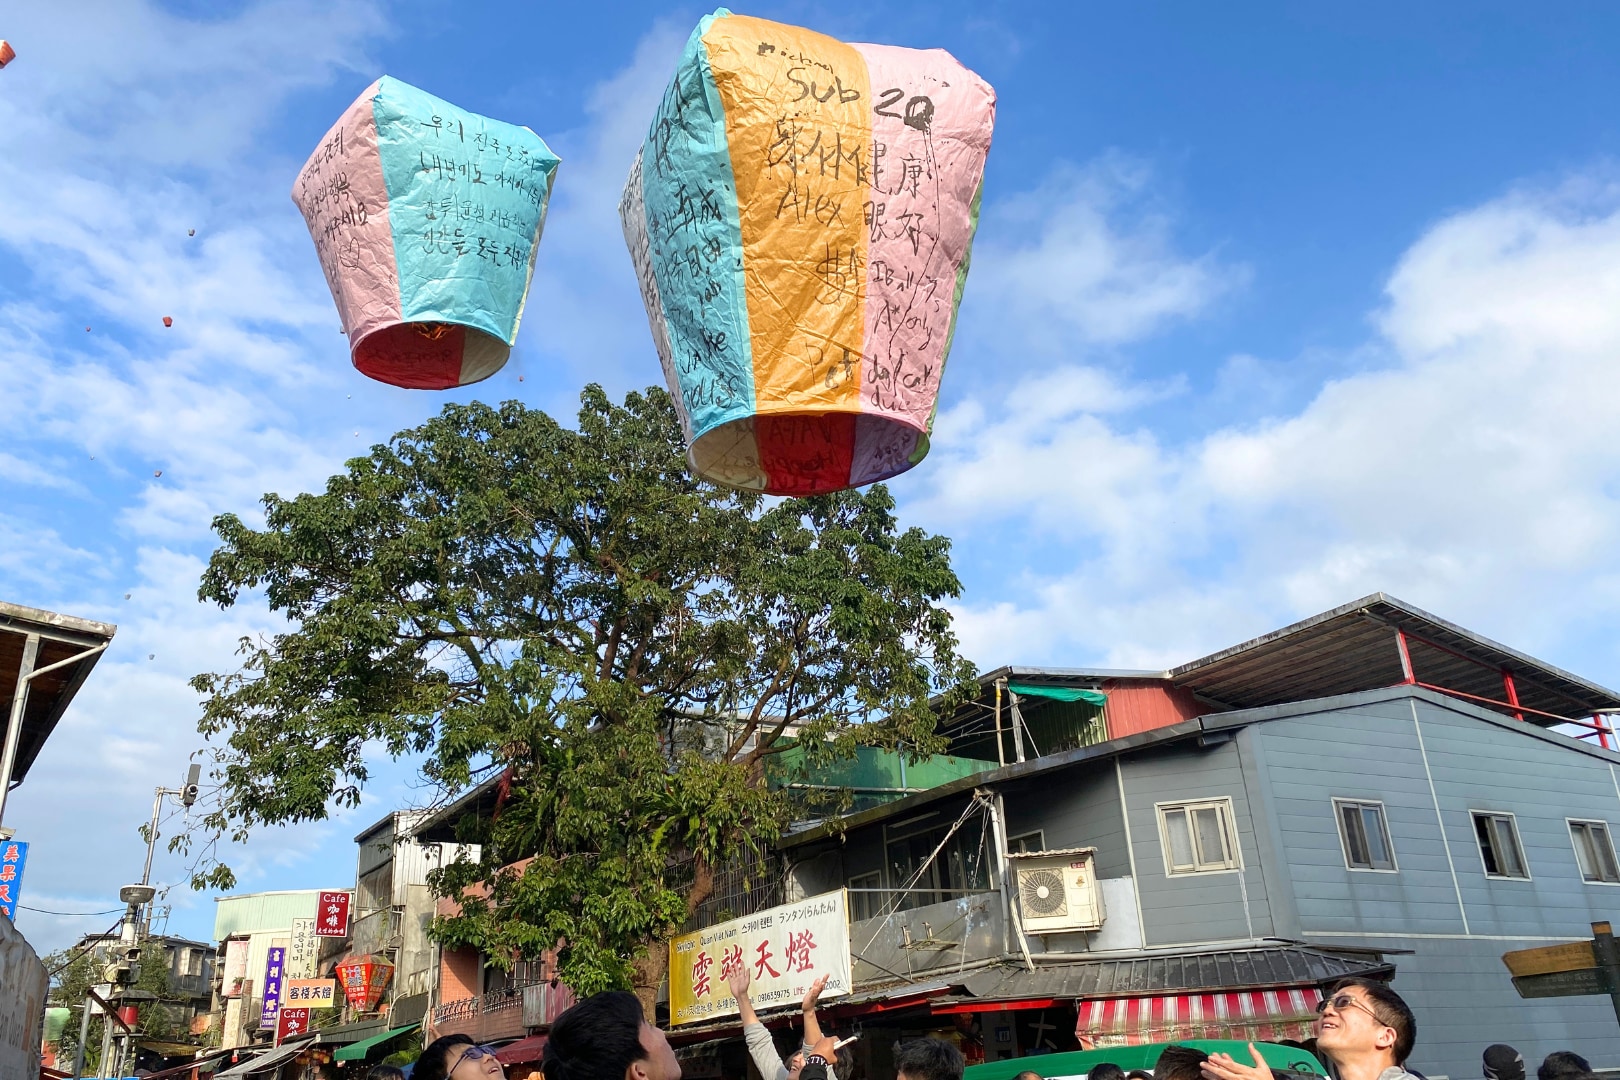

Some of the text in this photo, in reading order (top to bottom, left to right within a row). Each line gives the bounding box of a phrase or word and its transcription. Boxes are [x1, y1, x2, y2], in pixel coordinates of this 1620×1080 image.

[786, 67, 861, 104] Sub
[775, 182, 846, 230] Alex
[323, 893, 346, 904] Cafe
[326, 904, 340, 927] 咖啡
[284, 1010, 306, 1019] Cafe
